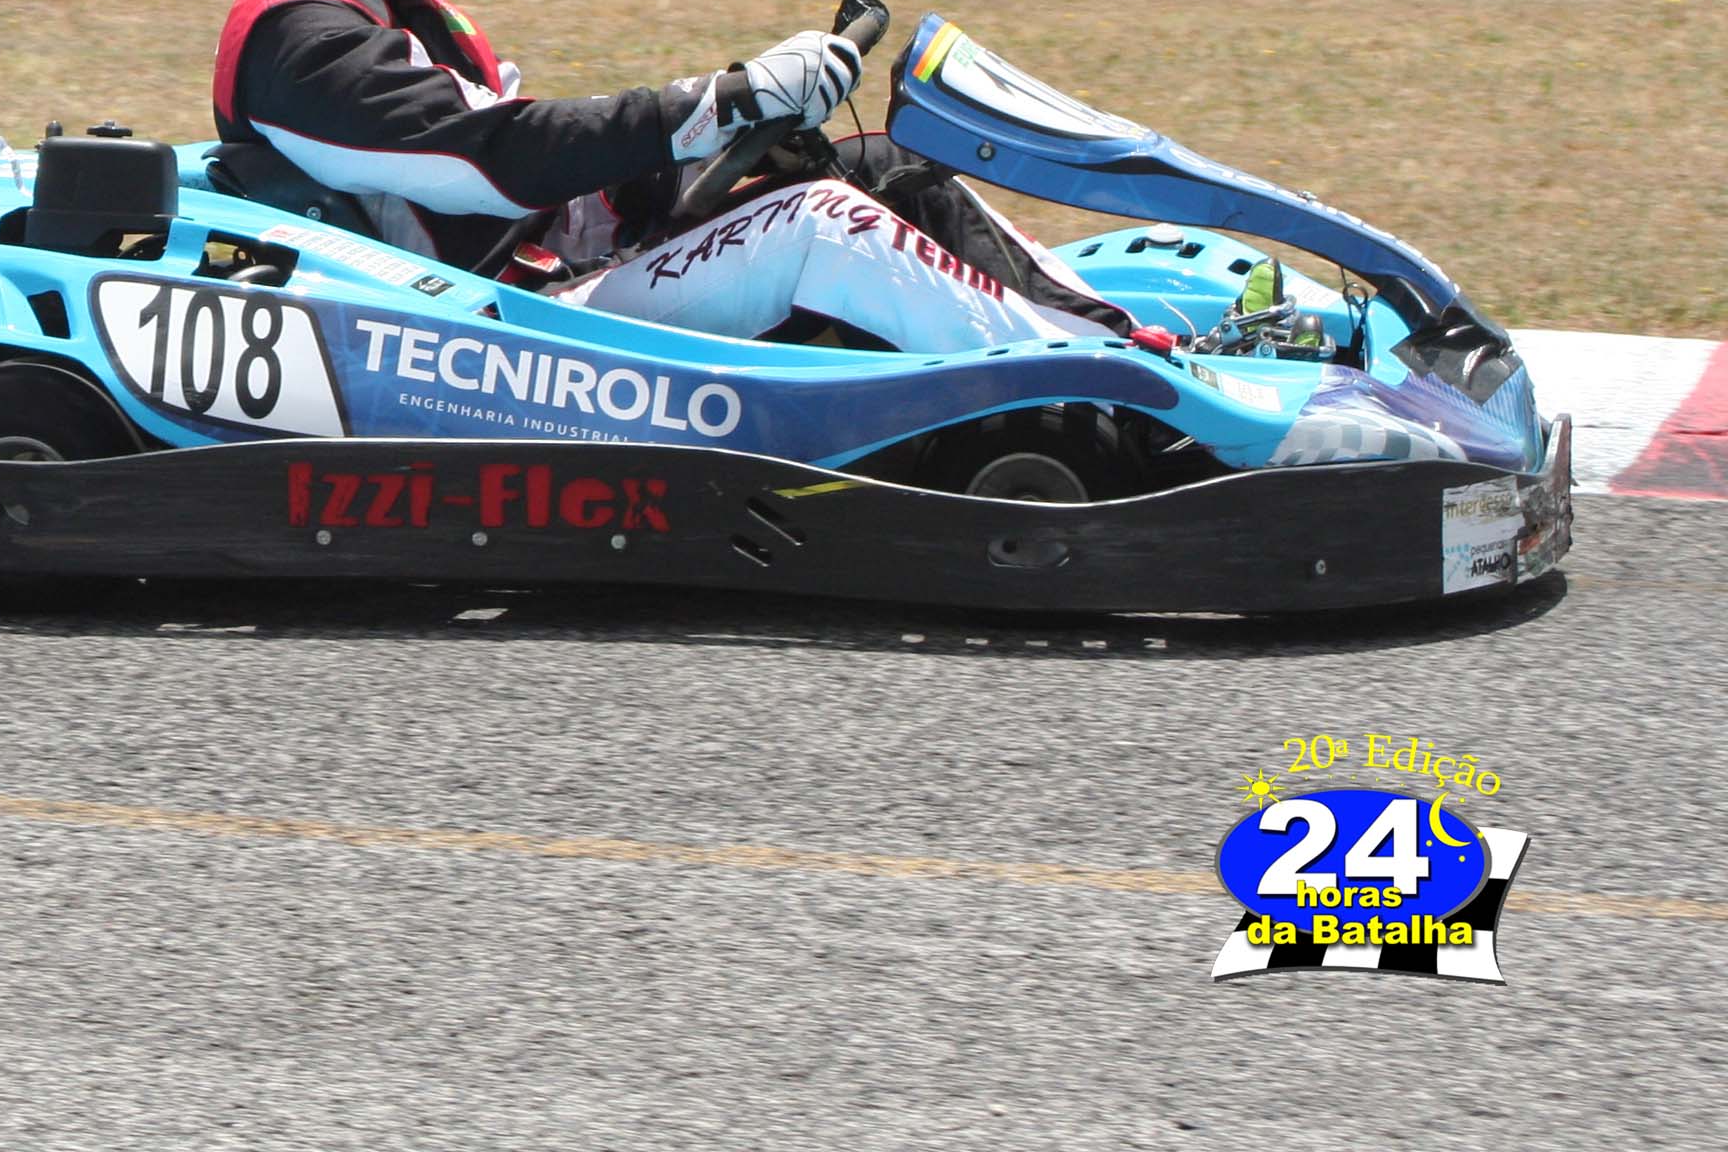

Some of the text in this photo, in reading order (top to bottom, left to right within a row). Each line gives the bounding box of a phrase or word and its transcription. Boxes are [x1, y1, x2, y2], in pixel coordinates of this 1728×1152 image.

[646, 189, 883, 289] KARTING
[138, 285, 283, 420] 108
[355, 319, 742, 438] TECNIROLO
[399, 393, 515, 426] ENGENHARIA
